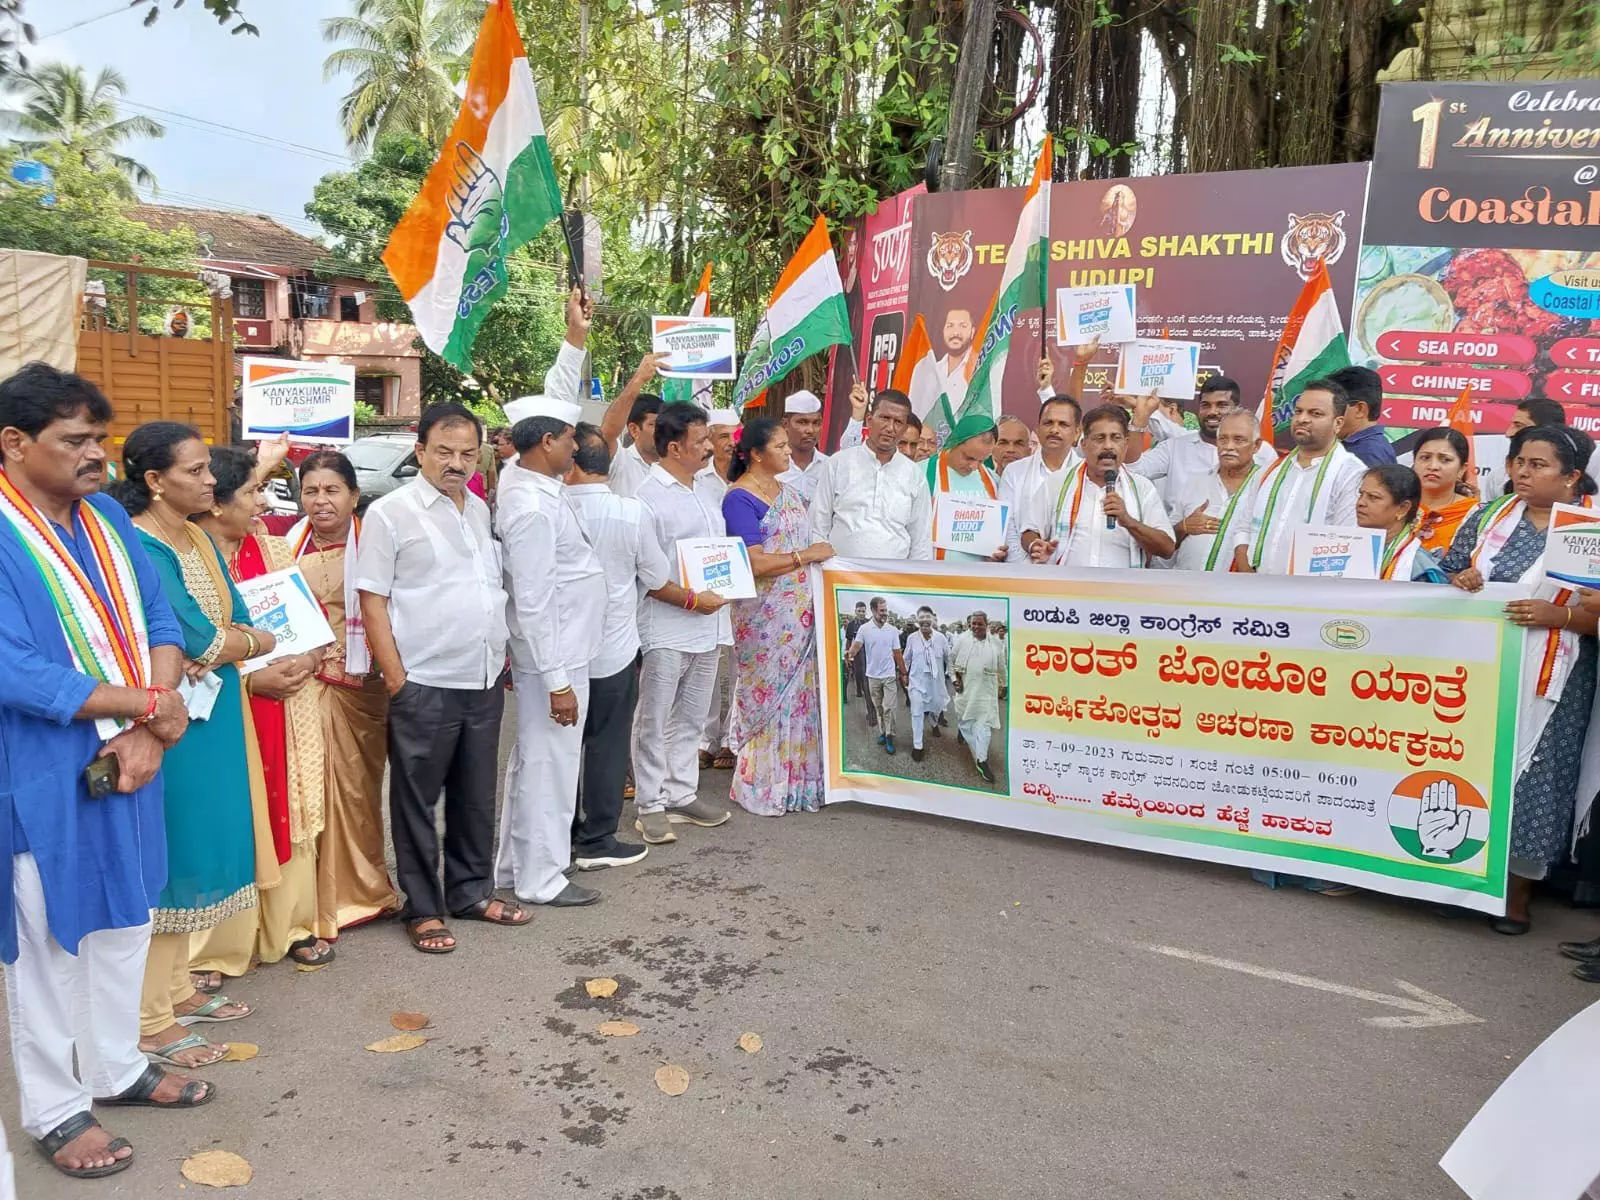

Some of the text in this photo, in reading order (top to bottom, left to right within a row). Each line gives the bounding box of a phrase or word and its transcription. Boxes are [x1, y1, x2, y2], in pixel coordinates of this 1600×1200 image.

[1573, 165, 1598, 185] @
[1418, 185, 1600, 226] Coastal
[1050, 237, 1132, 261] SHIVA
[1139, 232, 1274, 258] SHAKTHI
[1069, 267, 1155, 289] UDUPI
[1563, 274, 1588, 287] Visit
[1543, 292, 1593, 311] Coastal
[665, 334, 720, 344] KANYAKUMARI
[670, 341, 716, 351] TO KASHMIR
[873, 333, 897, 363] RED
[1417, 340, 1498, 357] SEA FOOD
[1143, 353, 1175, 365] BHARAT
[1144, 365, 1169, 376] JODO
[1139, 376, 1165, 388] YATRA
[1412, 375, 1492, 391] CHINESE
[263, 386, 337, 397] KANYAKUMARI
[269, 395, 331, 406] TO KASHMIR
[954, 509, 985, 520] BHARAT
[956, 521, 977, 531] JODO
[951, 532, 975, 542] YATRA
[1568, 545, 1580, 555] TO
[1023, 606, 1290, 638] ಉಡುಪಿ ಜಿಲ್ಲಾ ಕಾಂಗ್ರೆಸ್ ಸಮಿತಿ
[1025, 640, 1468, 724] ಭಾರತ್ ಜೋಡೋ ಯಾತ್ರೆ
[1024, 694, 1465, 767] ವಾರ್ಷಿಕೋತ್ಸವ ಆಚರಣಾ ಕಾರ್ಯಕ್ರಮ
[1121, 750, 1174, 767] ಗುರುವಾರ
[1189, 758, 1218, 772] ಸಂಜೆ
[1225, 761, 1255, 776] ಗಂಟೆ
[1318, 771, 1358, 788] 06:00
[1110, 768, 1148, 787] ಕಾಂಗ್ರೆಸ್
[1153, 774, 1206, 791] ಭವನದಿಂದ
[1317, 793, 1377, 818] ಪಾದಯಾತ್ರೆ
[1101, 790, 1206, 818] ಹೆಮ್ಮೆಯಿಂದ
[1216, 805, 1250, 833] ಹೆಜ್ಜೆ
[1261, 813, 1333, 836] ಹಾಕುವ
